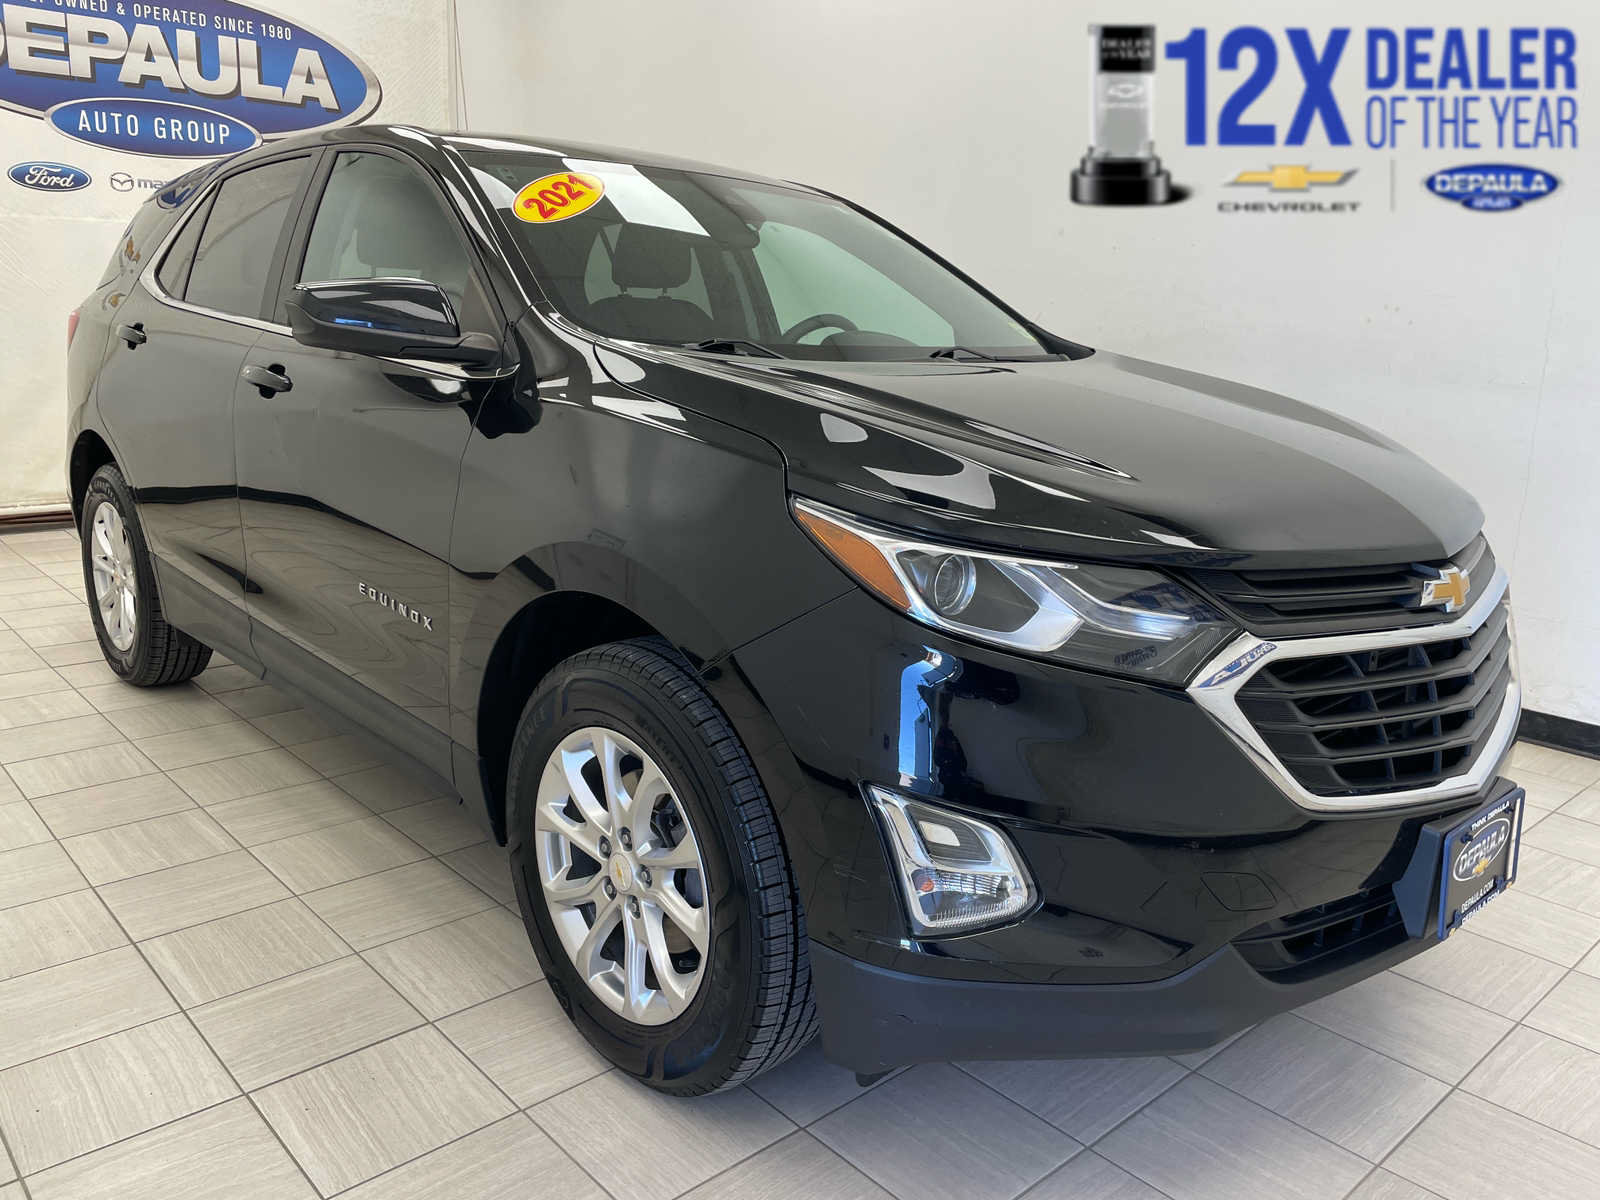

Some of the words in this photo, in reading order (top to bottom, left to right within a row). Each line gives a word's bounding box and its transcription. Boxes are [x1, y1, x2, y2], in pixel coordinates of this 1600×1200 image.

[116, 2, 126, 15] &
[133, 3, 207, 27] OPERATED
[214, 15, 255, 34] SINCE
[261, 23, 292, 41] 1980
[0, 3, 340, 111] EPAULA
[78, 109, 139, 136] AUTO
[154, 118, 231, 146] GROUP
[24, 165, 75, 188] Ford
[522, 174, 594, 219] 2021
[358, 581, 433, 632] EQUINOX
